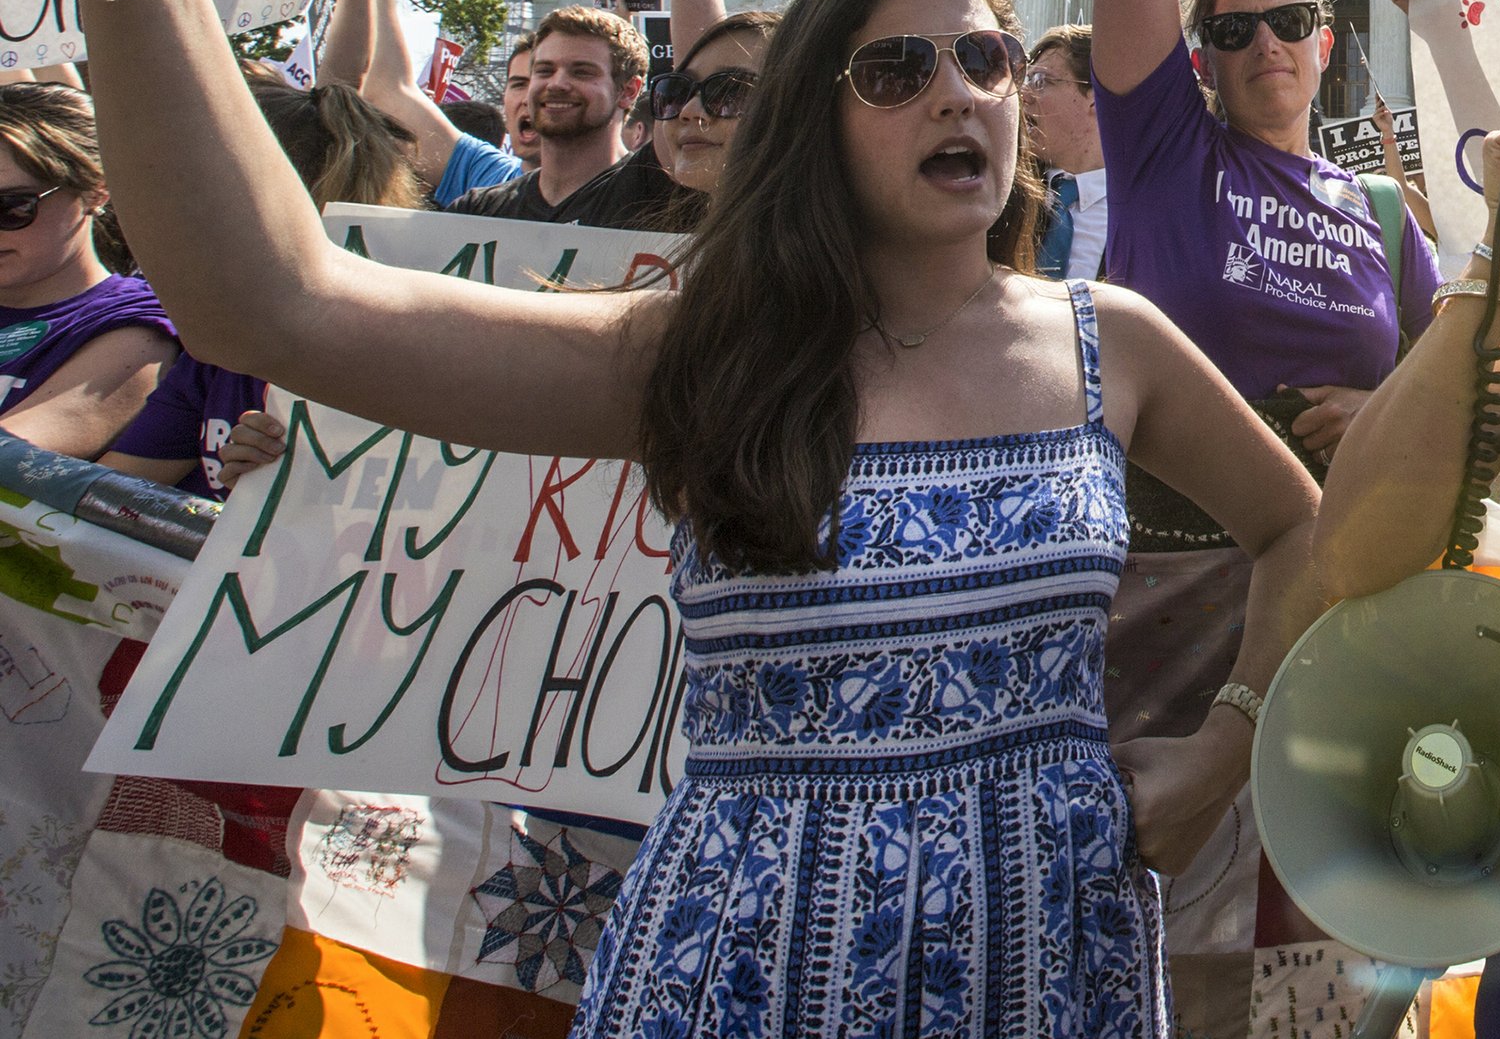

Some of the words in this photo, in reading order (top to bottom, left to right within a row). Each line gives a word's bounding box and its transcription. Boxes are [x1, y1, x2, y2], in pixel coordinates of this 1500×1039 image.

[1330, 127, 1346, 148] I
[1334, 139, 1418, 165] PRO-LFE
[1215, 171, 1225, 203] I
[1227, 186, 1253, 218] m
[1260, 196, 1304, 229] Pro
[1247, 223, 1352, 275] America
[1267, 269, 1327, 298] NARAL
[1265, 283, 1326, 310] Pro-Choice
[1329, 300, 1375, 318] America
[1416, 746, 1457, 774] RadioShack
